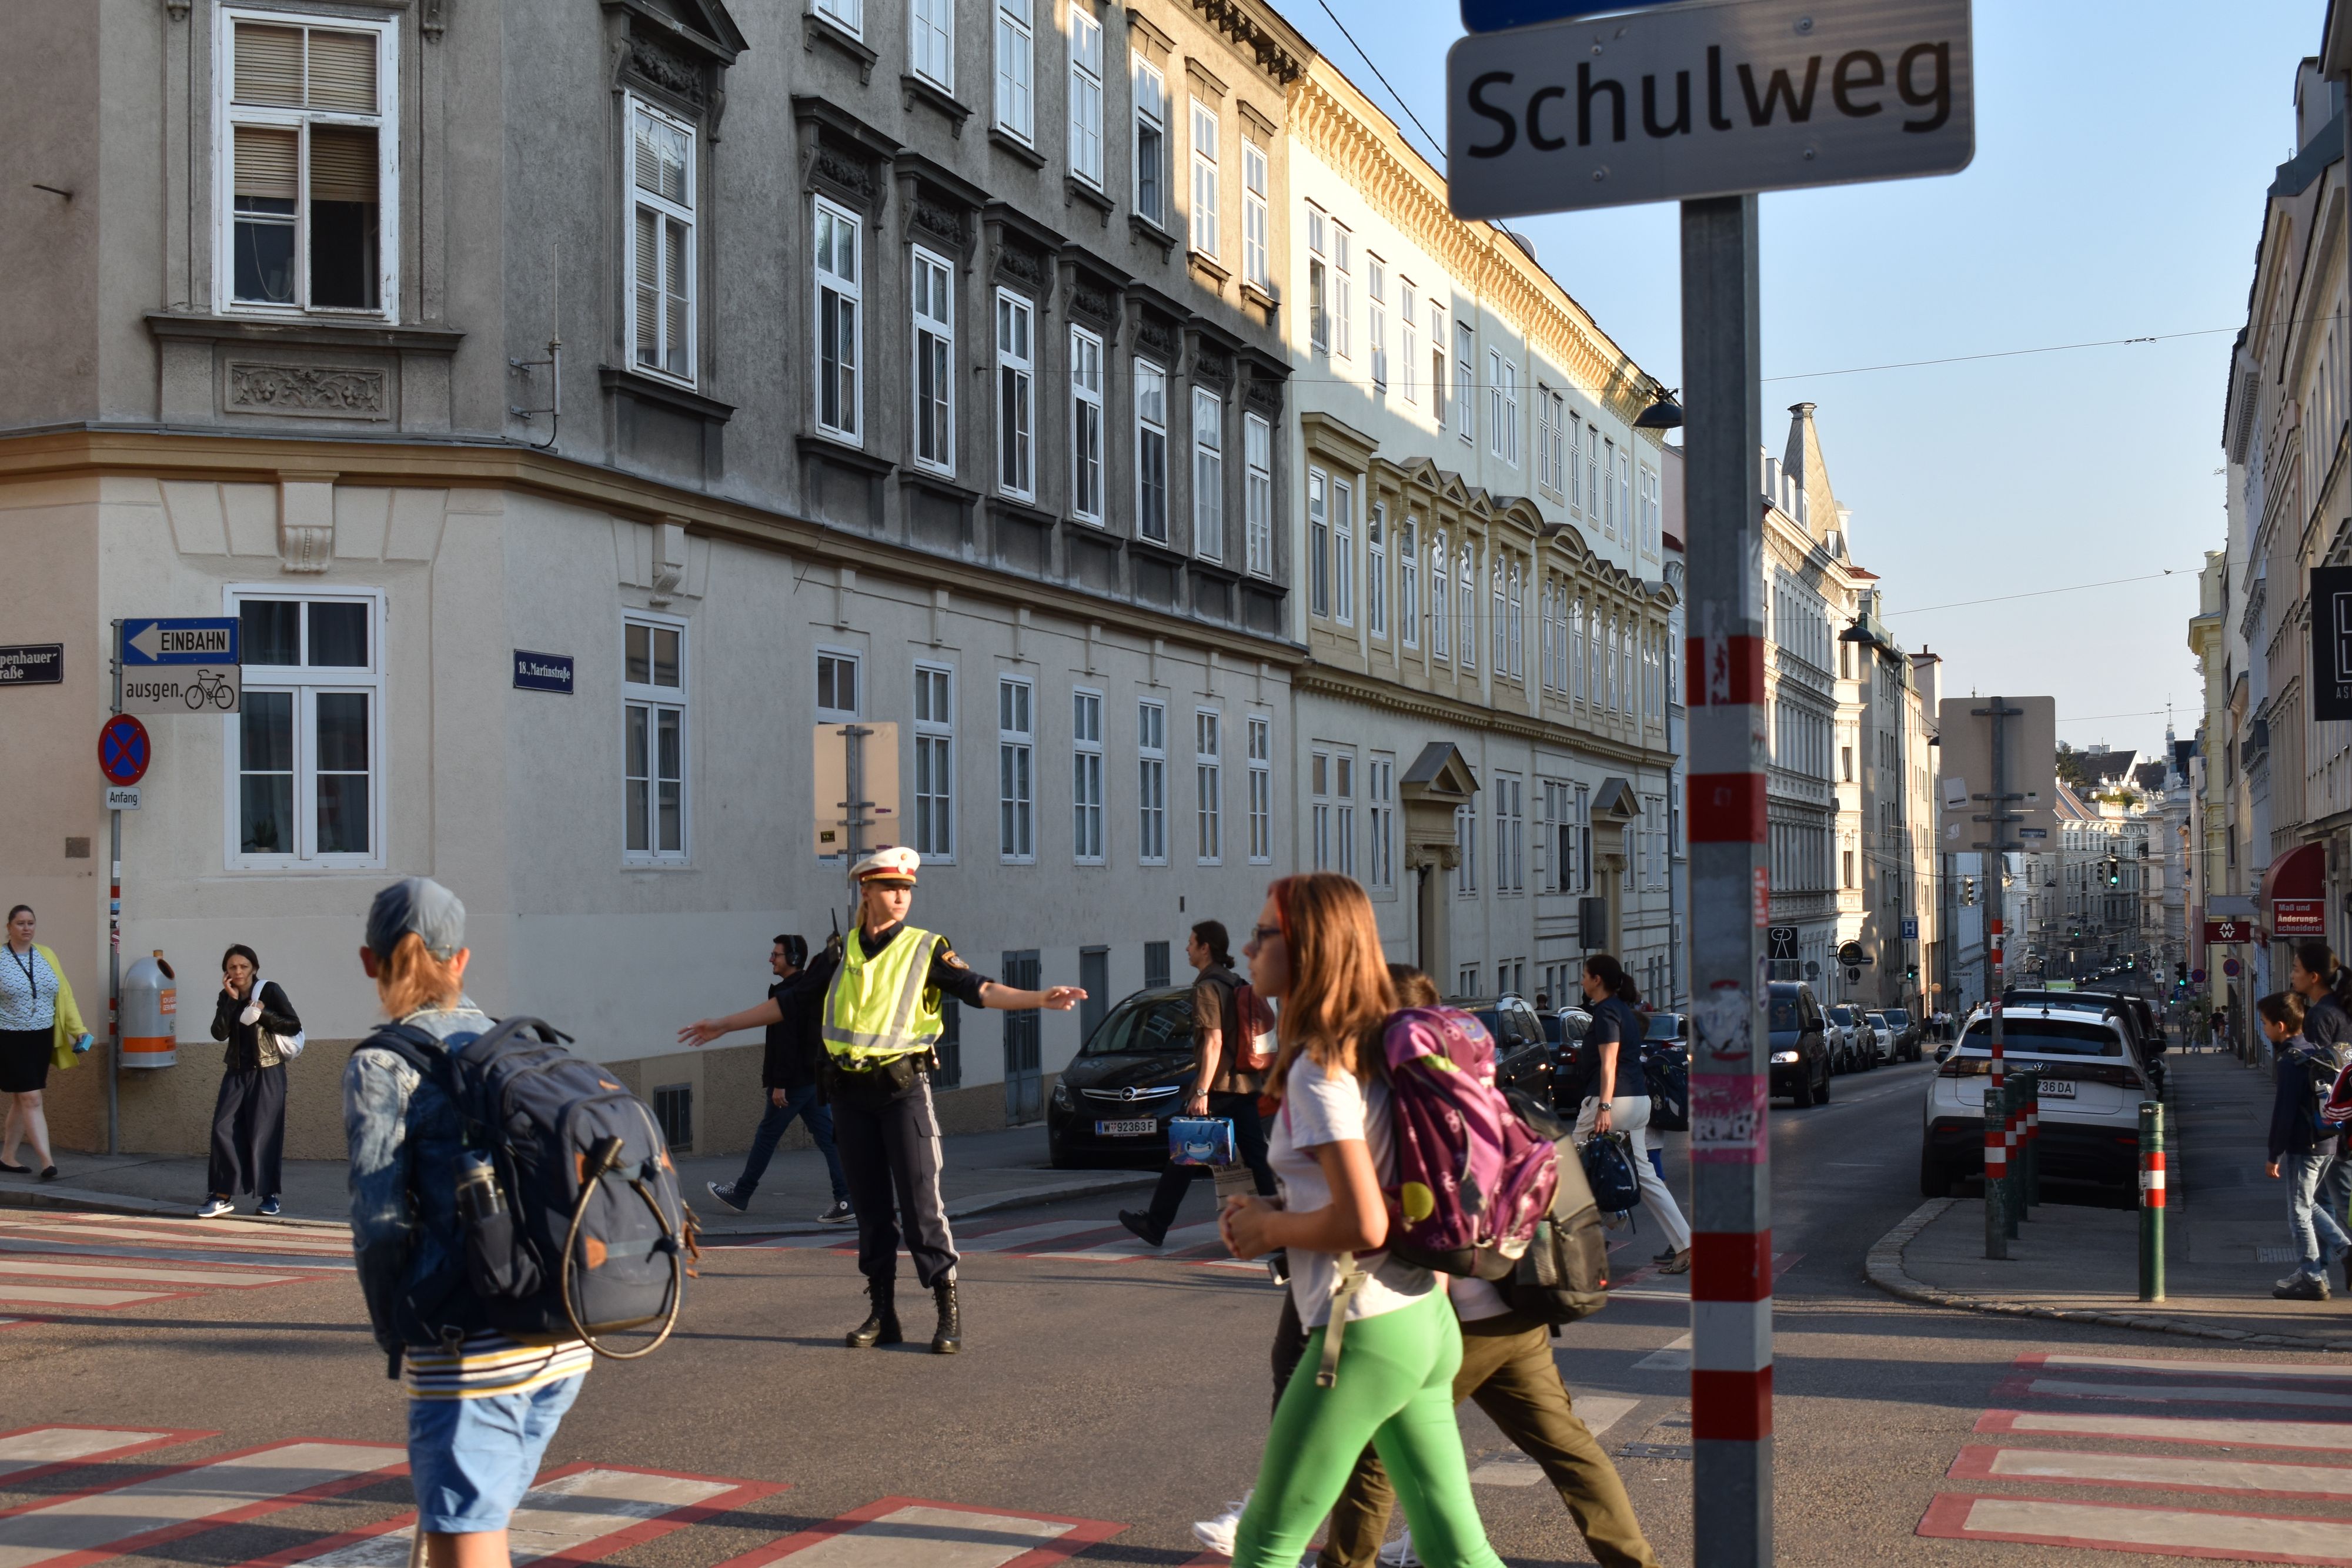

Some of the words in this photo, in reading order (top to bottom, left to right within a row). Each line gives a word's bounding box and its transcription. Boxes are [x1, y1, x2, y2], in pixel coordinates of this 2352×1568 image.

[1467, 41, 1950, 159] Schulweg
[161, 631, 225, 651] EINBAHN
[126, 682, 183, 702] ausgen.
[2336, 686, 2352, 699] AS
[109, 791, 138, 806] Anfang
[2277, 913, 2323, 924] Änderungs-
[1904, 921, 1915, 934] H
[1103, 1122, 1111, 1132] W
